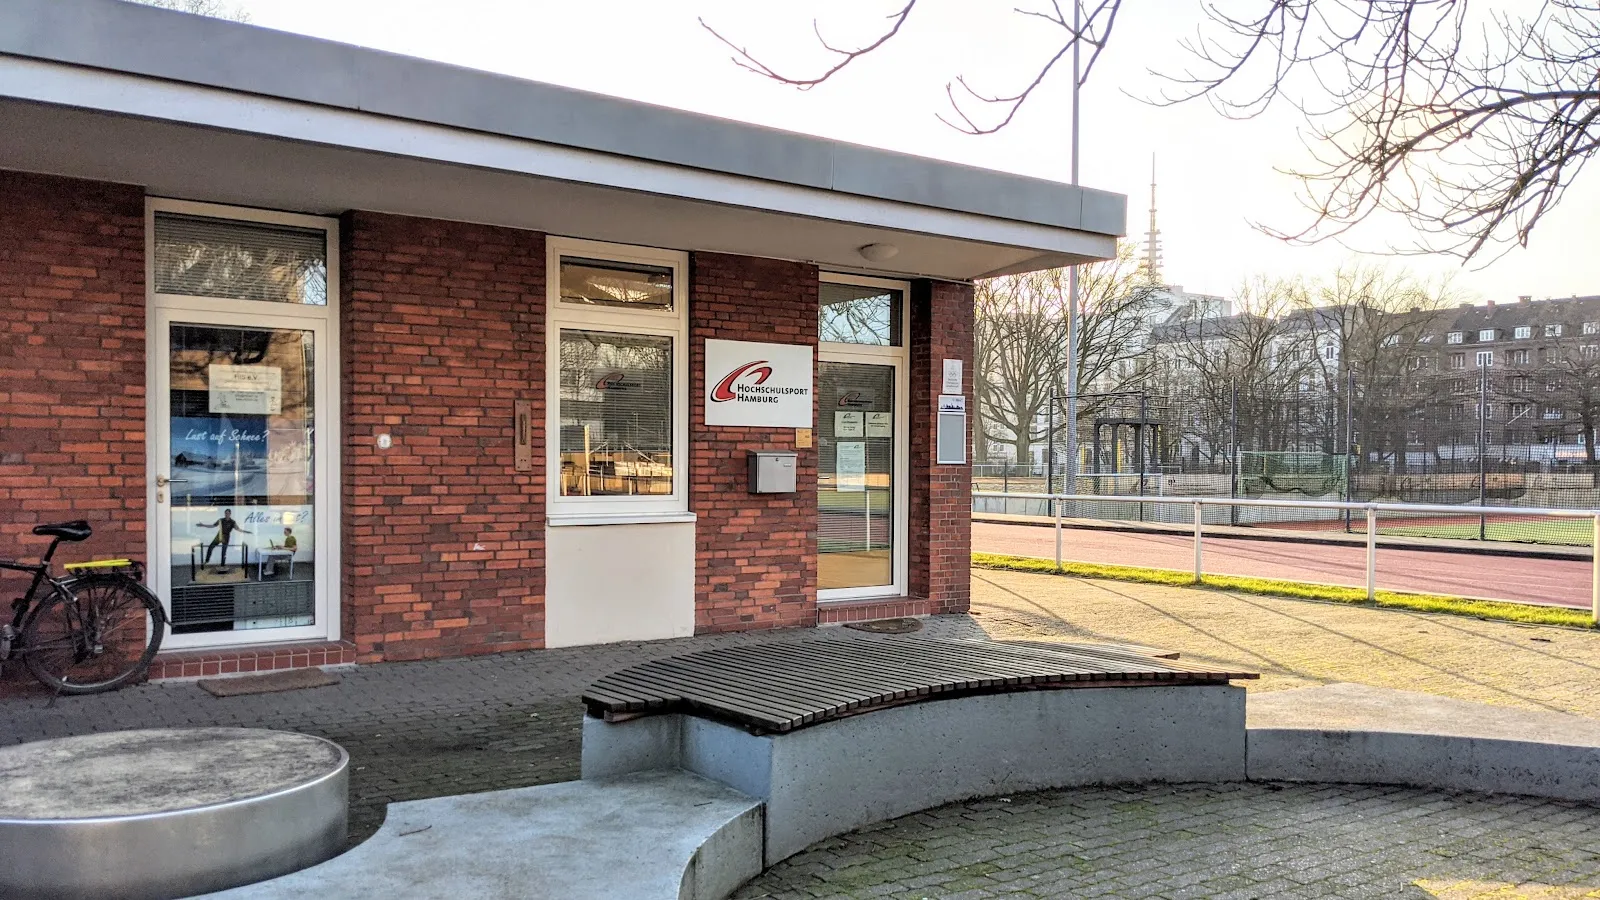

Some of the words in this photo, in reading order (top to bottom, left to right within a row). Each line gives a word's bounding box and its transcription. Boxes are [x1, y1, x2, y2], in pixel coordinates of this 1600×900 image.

[737, 384, 808, 395] HOCHSCHULSPORT
[737, 394, 779, 403] HAMBURG
[185, 428, 208, 441] Lust
[210, 429, 226, 445] auf
[229, 428, 269, 442] Schnee?
[244, 511, 270, 523] Alles
